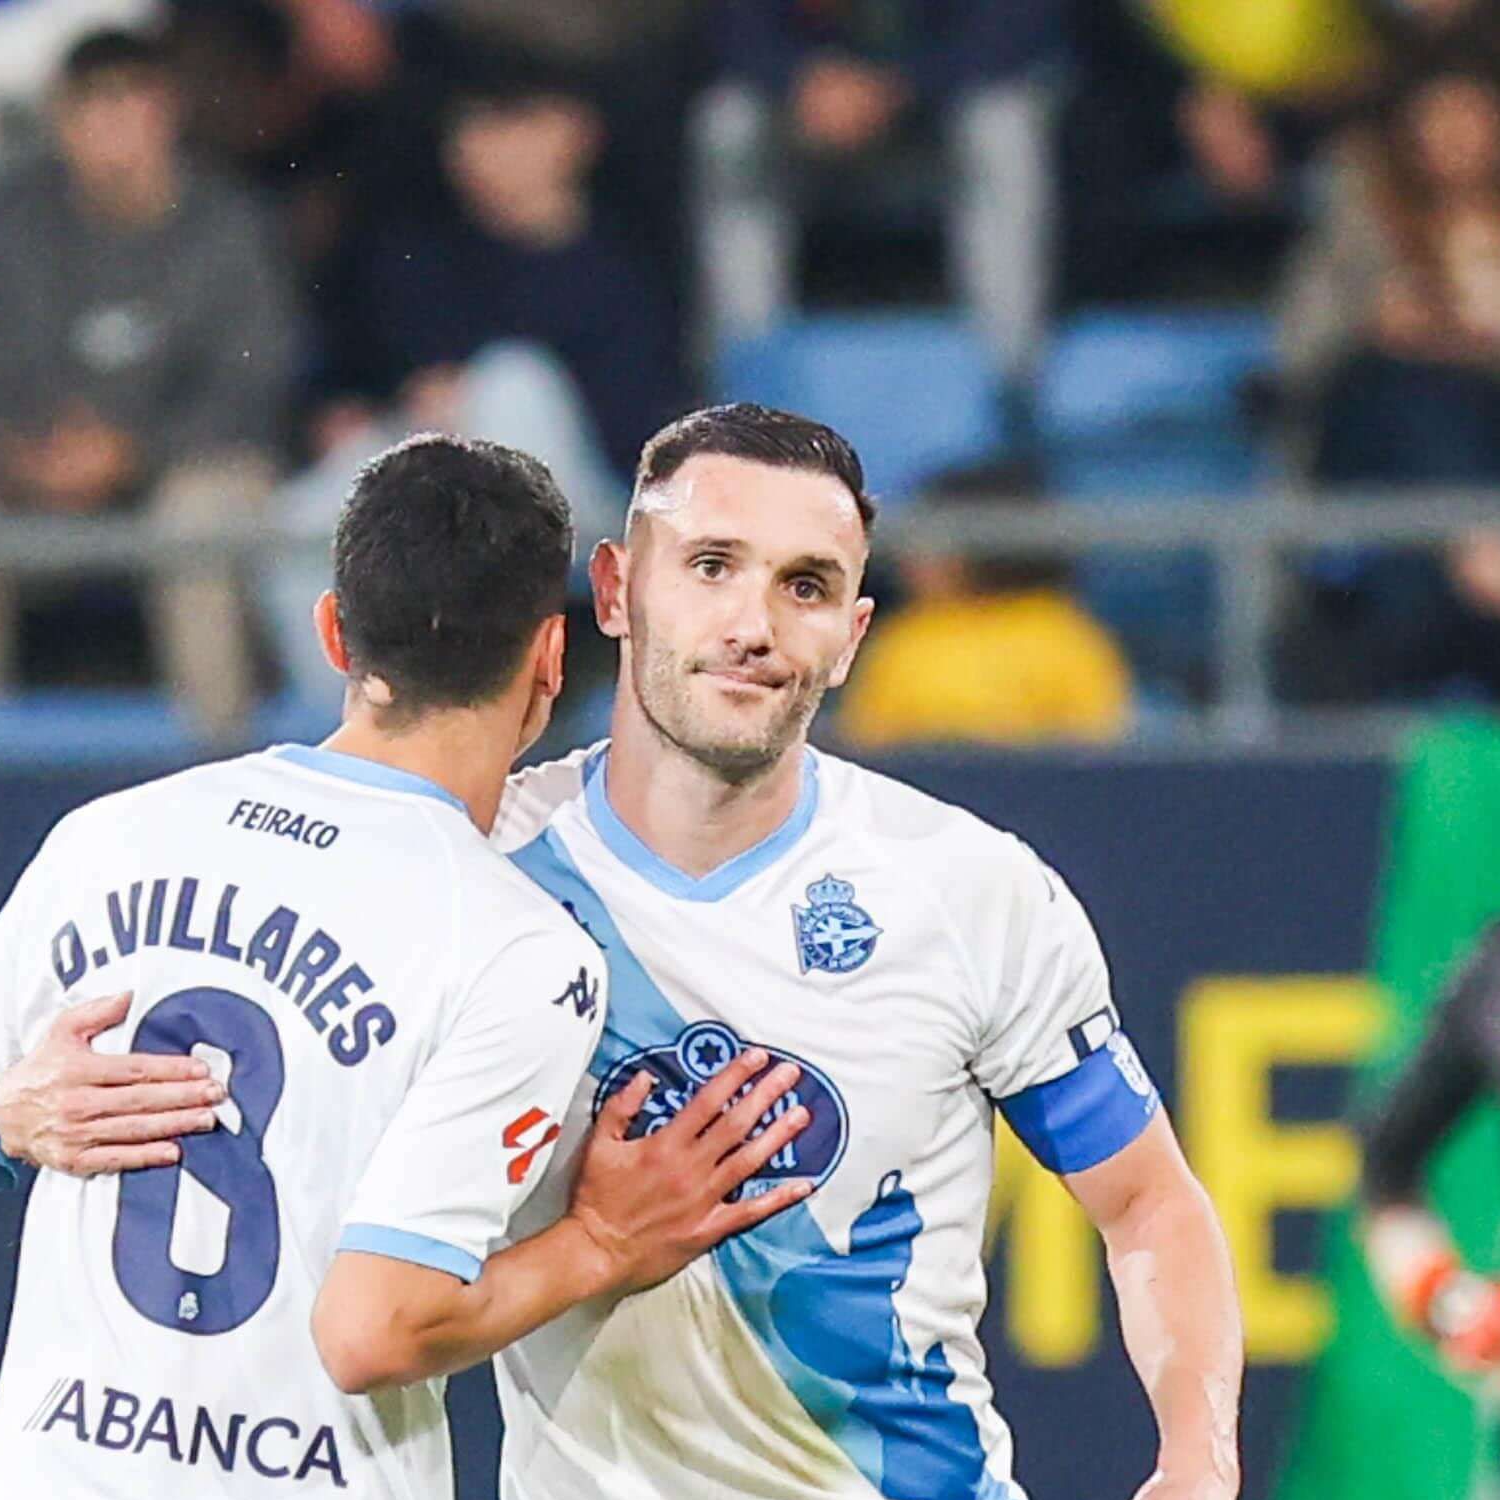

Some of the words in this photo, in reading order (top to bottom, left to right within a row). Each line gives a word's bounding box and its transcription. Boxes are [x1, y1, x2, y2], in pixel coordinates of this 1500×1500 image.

[227, 799, 340, 849] FEIRACO
[50, 876, 397, 1068] D.VILLARES
[112, 986, 286, 1336] 8
[42, 1378, 348, 1488] ABANCA
